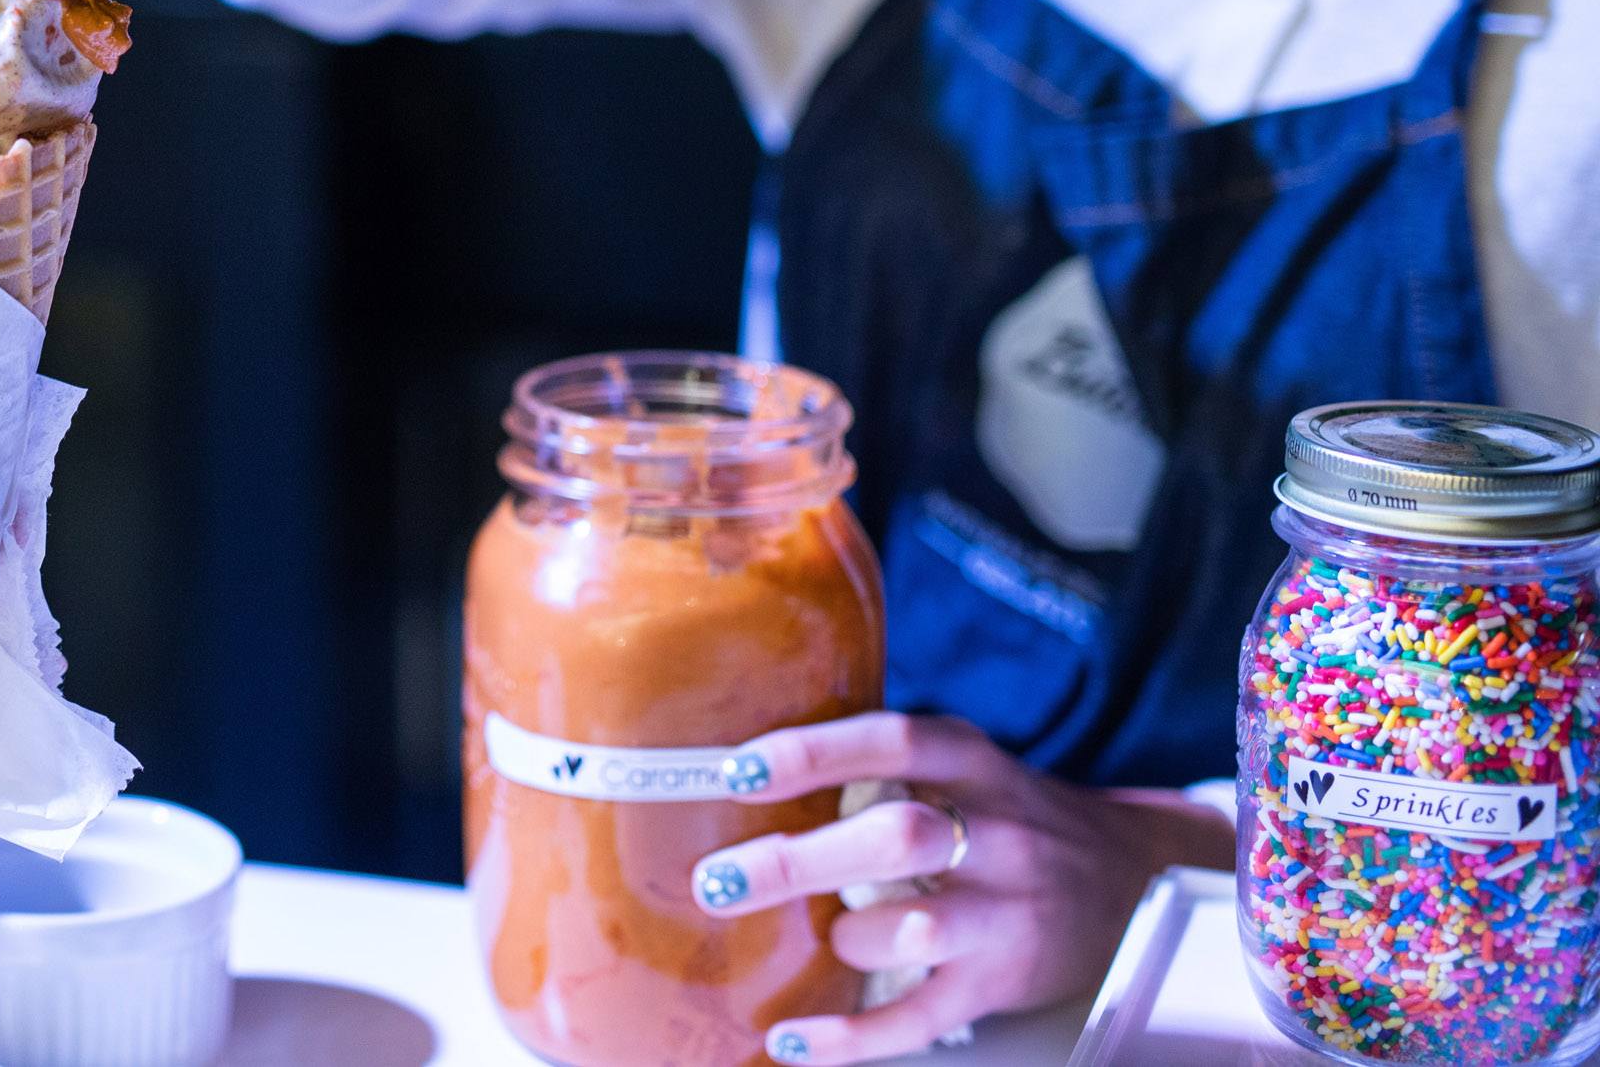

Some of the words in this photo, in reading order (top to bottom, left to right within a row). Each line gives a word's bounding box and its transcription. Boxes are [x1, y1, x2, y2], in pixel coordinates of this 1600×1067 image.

[1361, 490, 1380, 506] 70
[1384, 495, 1418, 511] mm
[1352, 787, 1498, 824] Sprinkles
